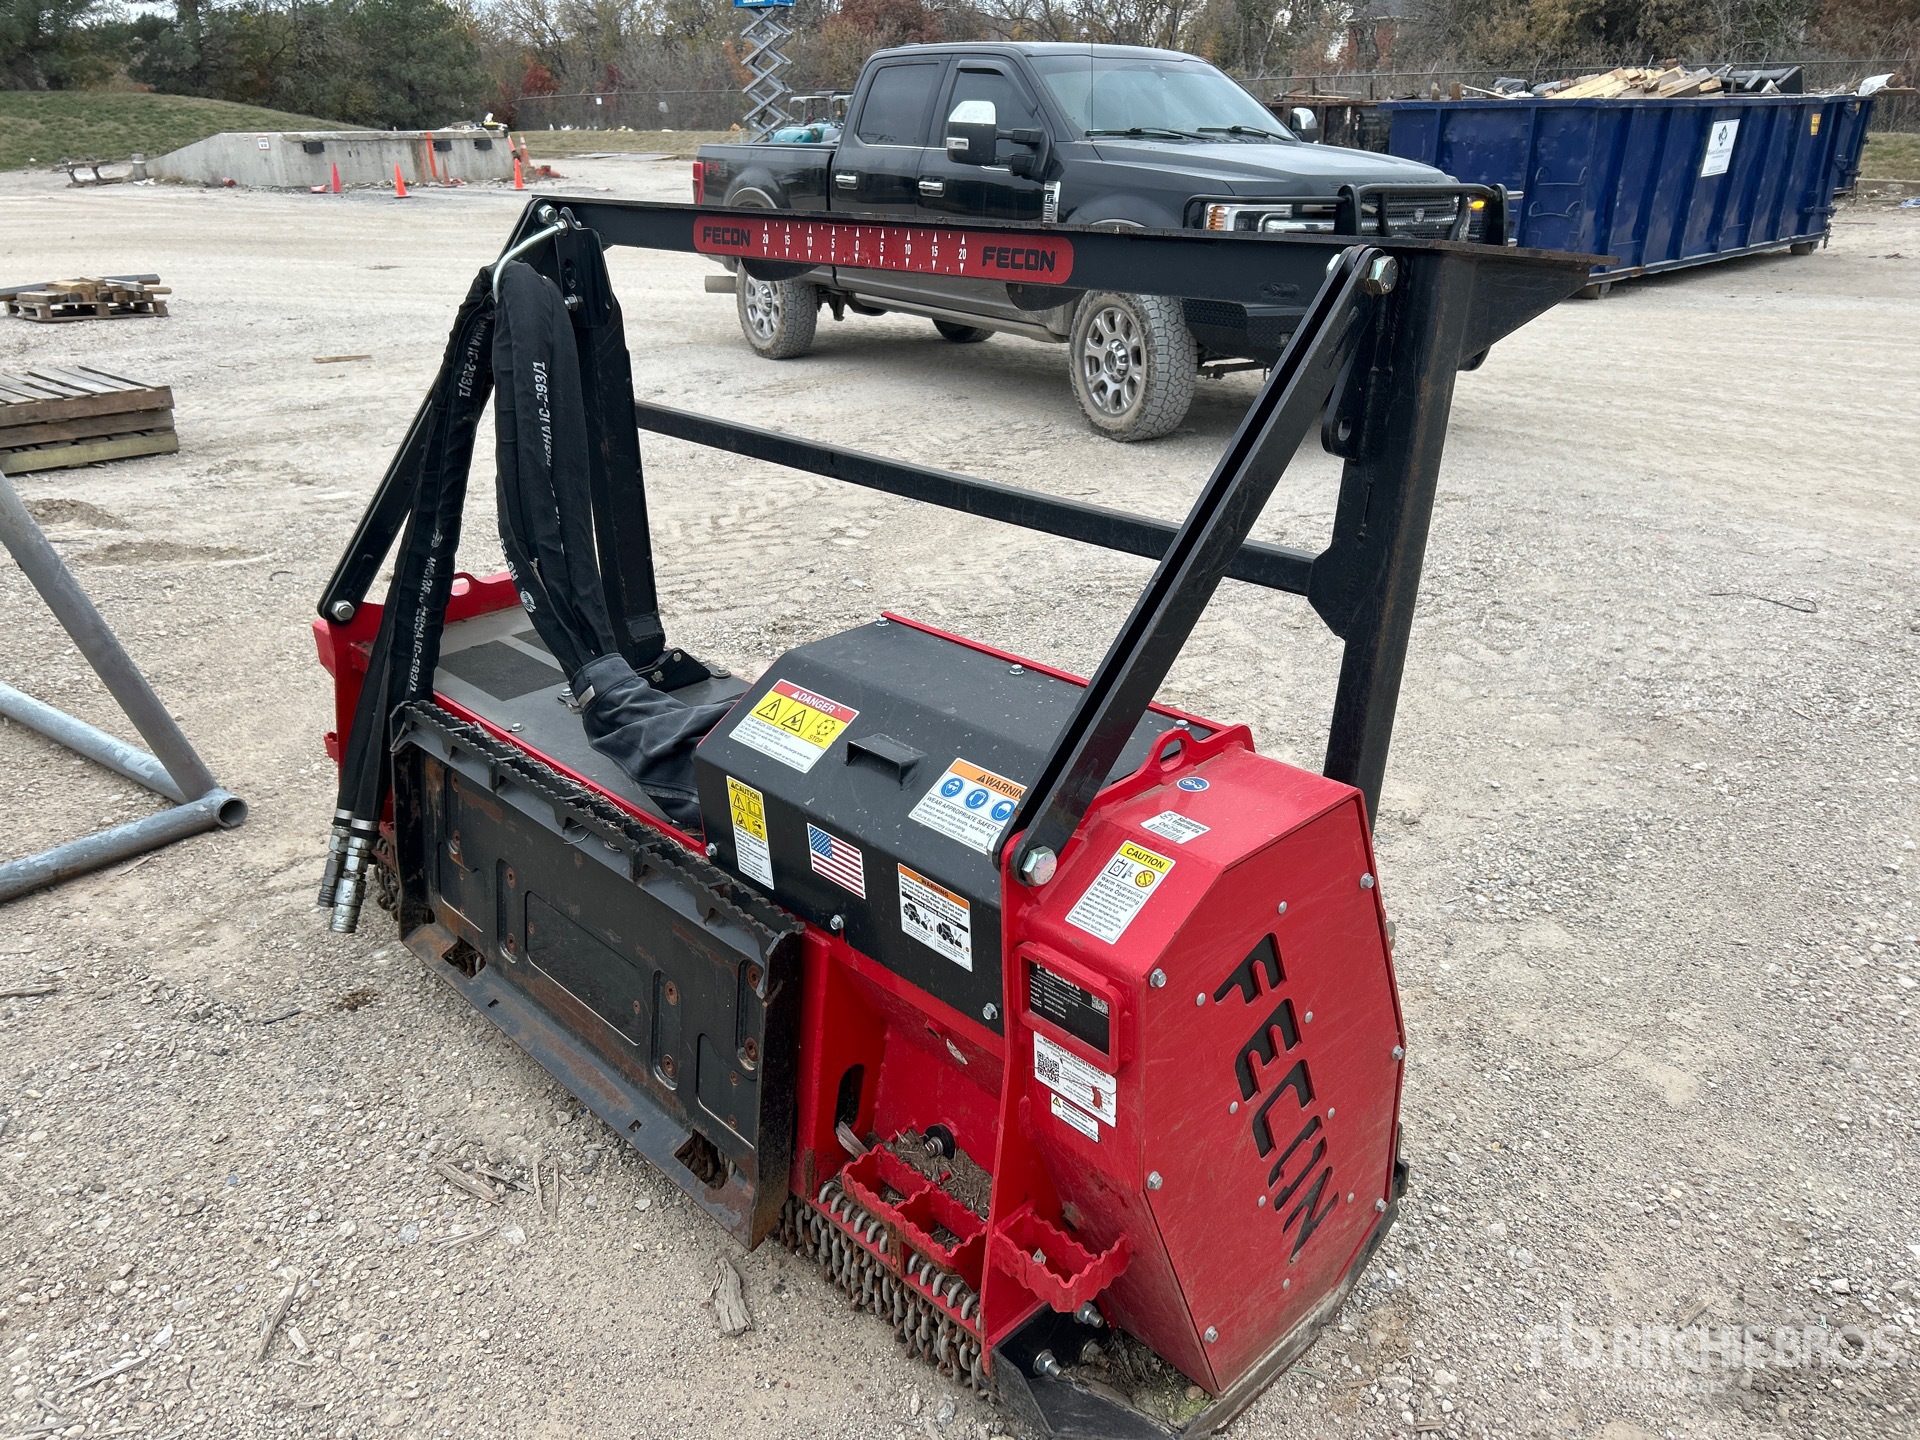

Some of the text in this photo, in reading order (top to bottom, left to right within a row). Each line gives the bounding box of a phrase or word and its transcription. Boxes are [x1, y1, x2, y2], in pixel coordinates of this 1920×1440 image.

[702, 226, 1056, 272] FECON 20 15 10 5 0 5 10 15 20 FECON
[533, 361, 551, 421] IC-293/1
[799, 694, 835, 713] DANGER
[808, 735, 823, 744] STOP
[735, 784, 760, 801] CAUTION
[984, 777, 1024, 798] WARNIN
[927, 796, 997, 832] WEAR APPROPRIATE SAFETY
[1126, 848, 1164, 868] CAUTION
[922, 878, 949, 898] WARNING
[1097, 881, 1140, 905] Before Operating
[1101, 876, 1143, 899] Warm Hydraulics
[1212, 932, 1340, 1264] FECON
